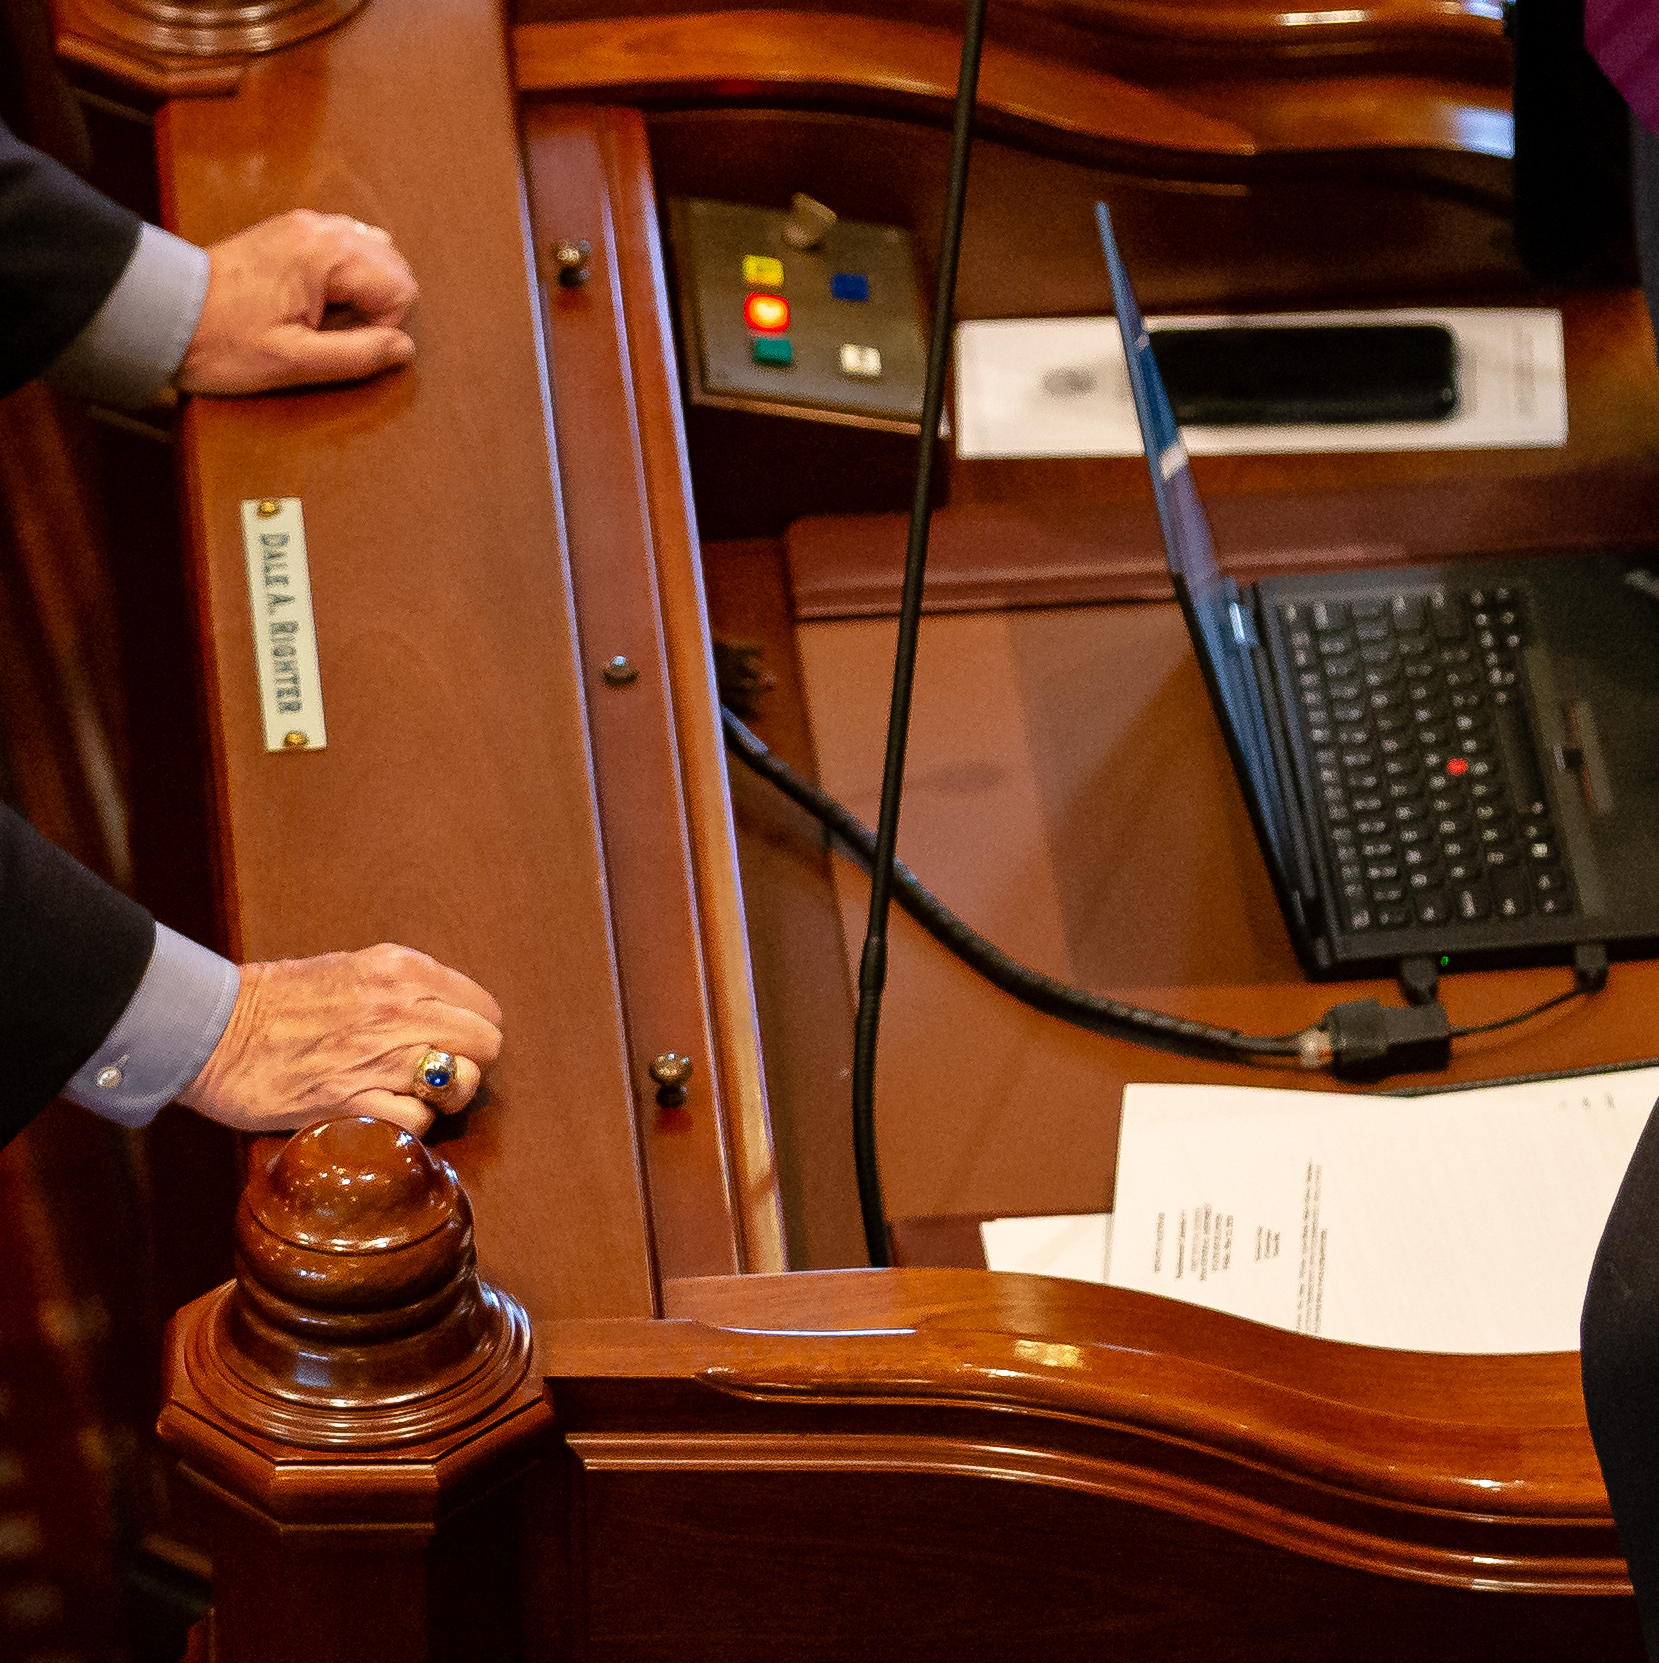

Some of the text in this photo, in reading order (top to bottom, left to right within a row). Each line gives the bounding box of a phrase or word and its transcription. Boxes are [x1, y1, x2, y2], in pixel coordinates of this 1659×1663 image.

[259, 532, 303, 715] DALE A. RIGHTER
